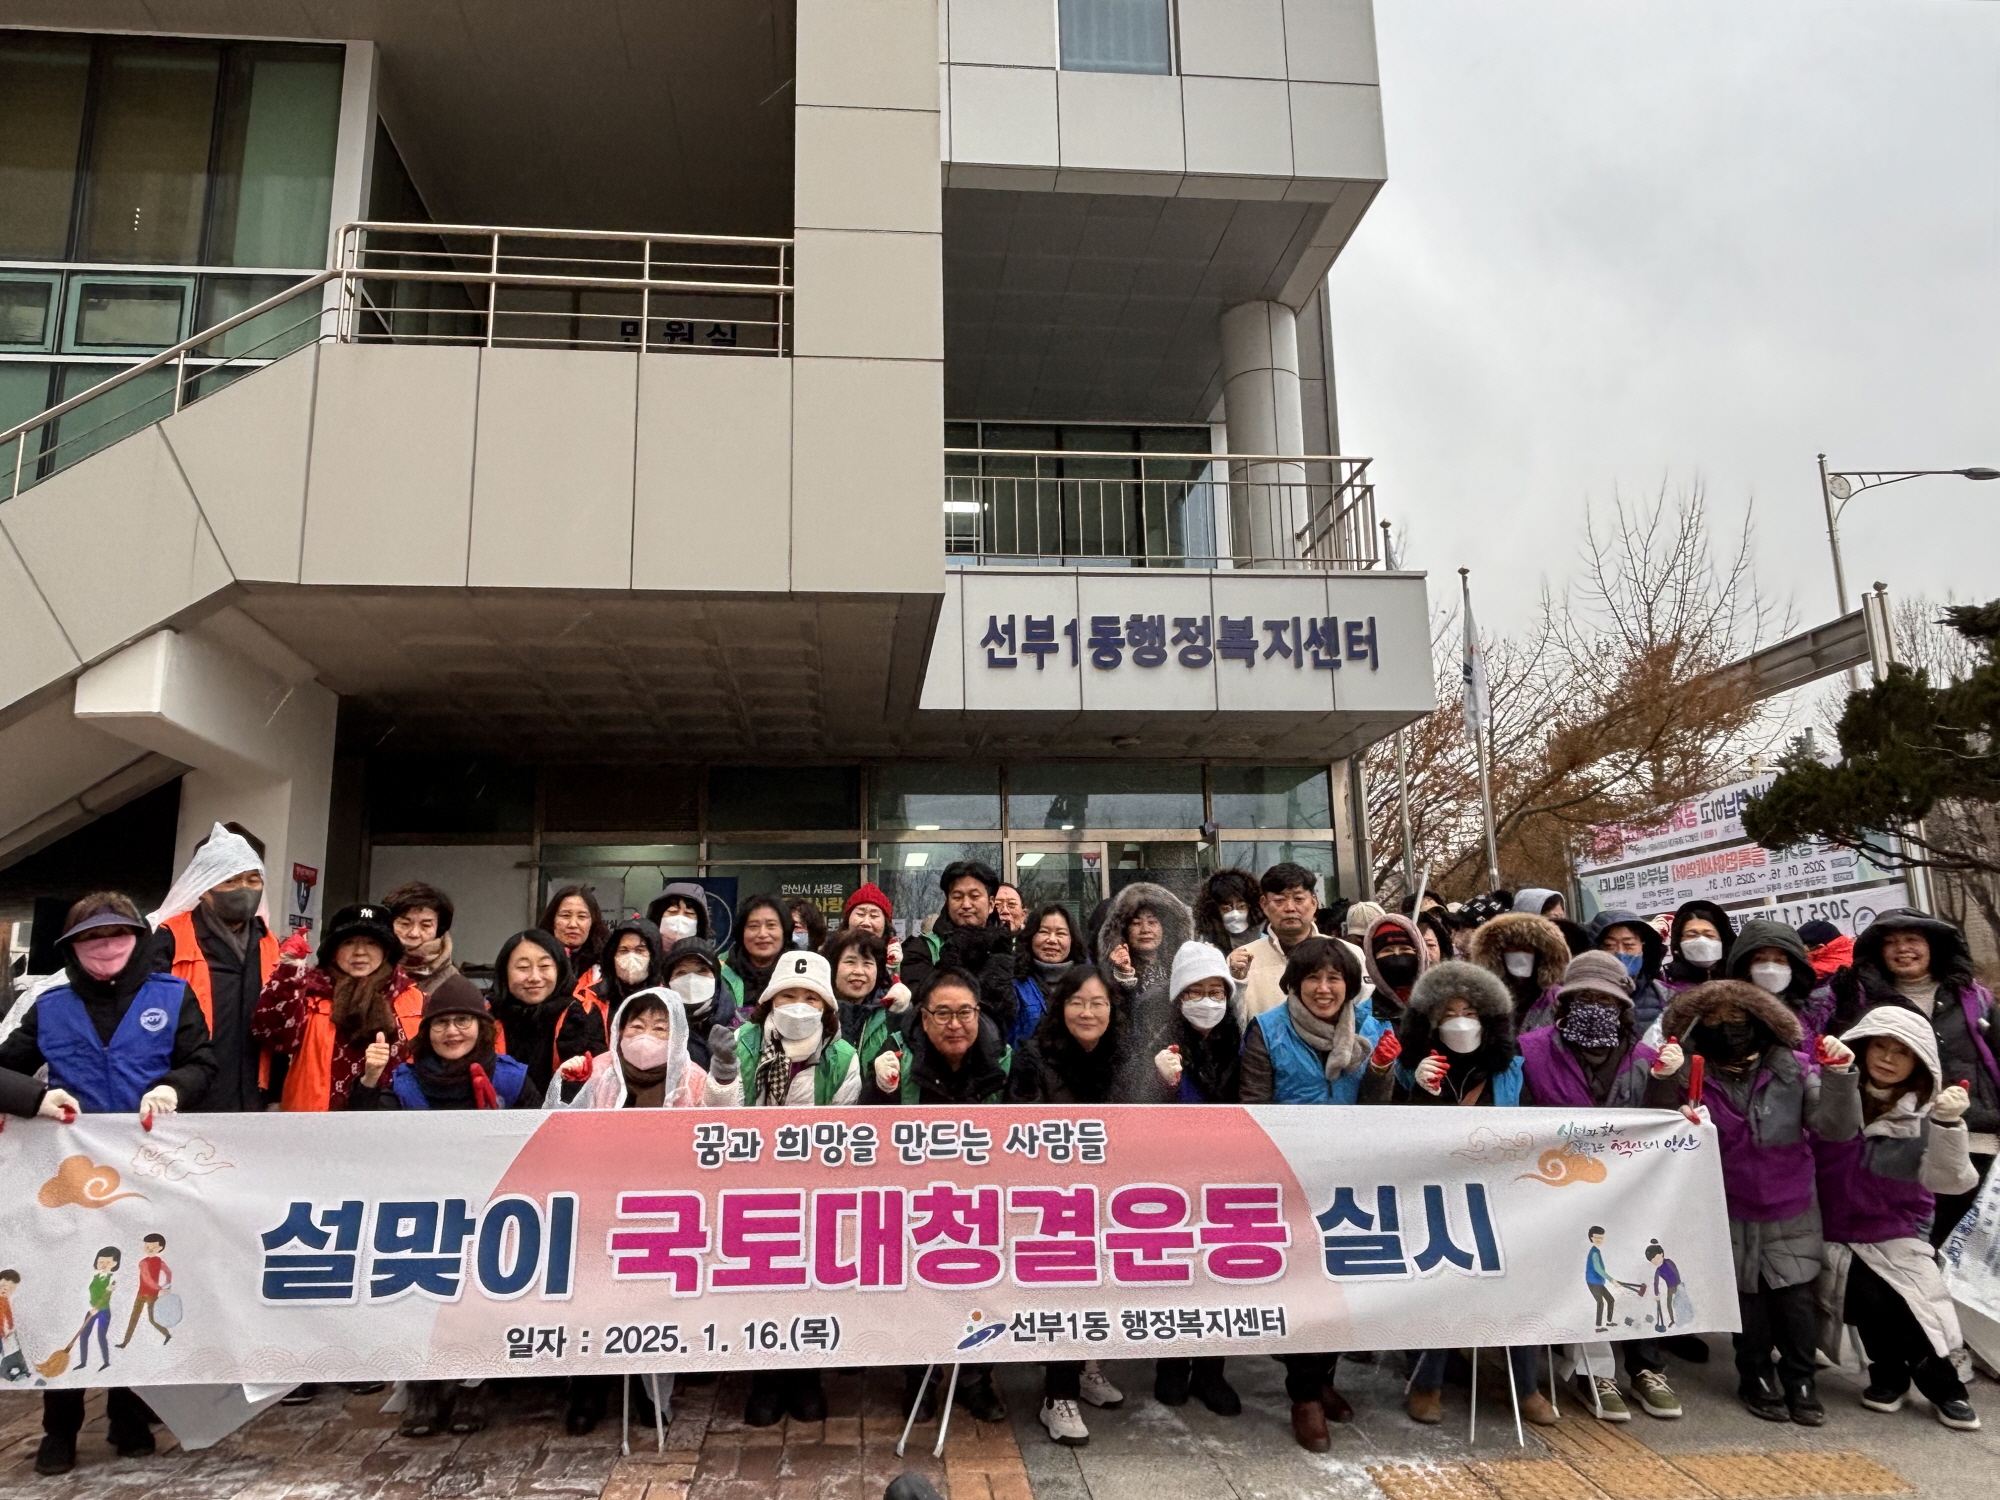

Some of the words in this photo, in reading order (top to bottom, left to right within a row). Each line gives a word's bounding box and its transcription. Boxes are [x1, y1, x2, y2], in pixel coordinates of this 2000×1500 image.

[980, 614, 1379, 670] 선부1동행정복지센터
[795, 959, 807, 974] C
[696, 1125, 761, 1166] 꿈과
[776, 1124, 877, 1164] 희망을
[895, 1123, 989, 1163] 만드는
[1006, 1122, 1105, 1162] 사람들
[260, 1196, 576, 1300] 설맞이
[611, 1186, 1288, 1292] 국토대청결운동
[1315, 1182, 1501, 1276] 실시
[506, 1326, 567, 1359] 일자
[579, 1331, 589, 1353] :
[605, 1325, 688, 1354] 2025.
[703, 1323, 729, 1352] 1.
[744, 1316, 840, 1351] 16.(목)
[1009, 1309, 1110, 1343] 선부1동
[1121, 1306, 1286, 1341] 행정복지센터
